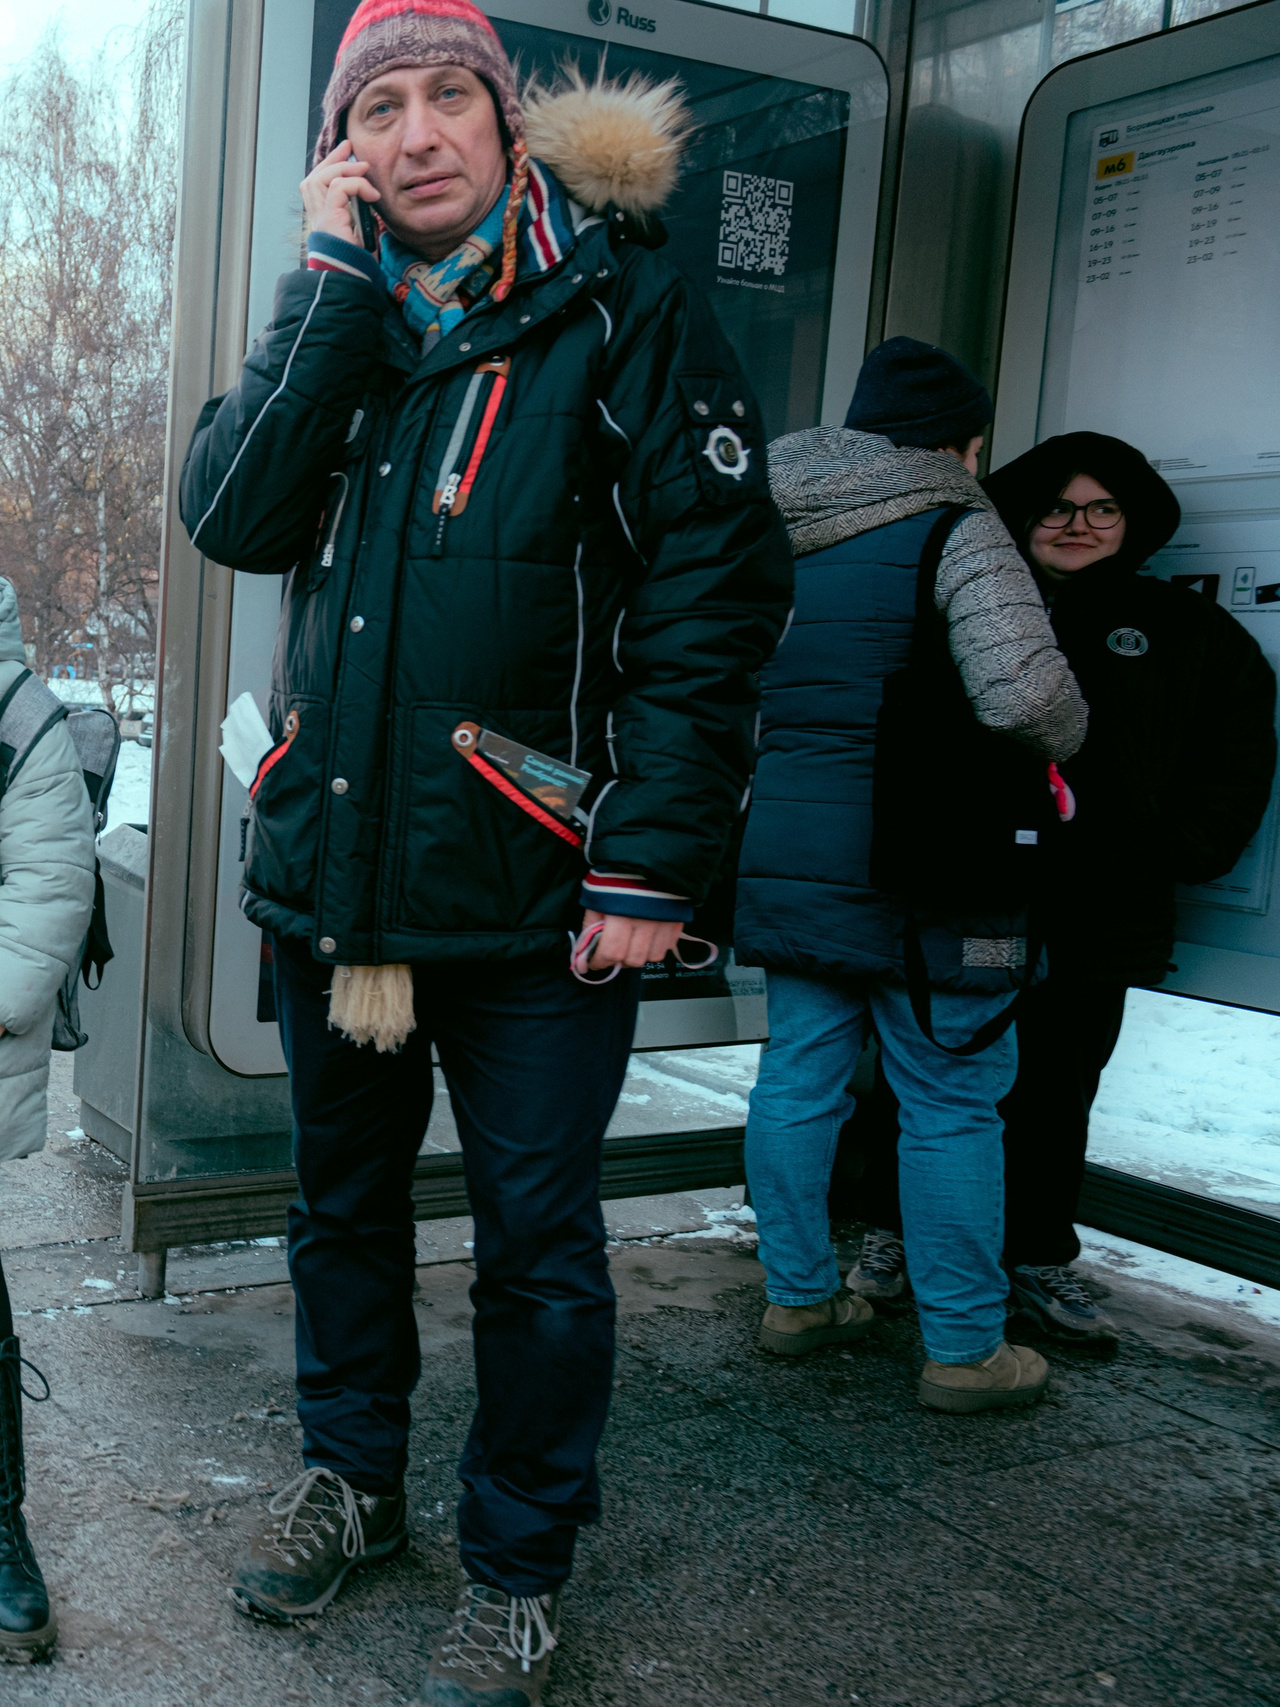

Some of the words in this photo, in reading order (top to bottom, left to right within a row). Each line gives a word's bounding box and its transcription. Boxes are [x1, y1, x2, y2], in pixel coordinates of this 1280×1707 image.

[617, 7, 657, 33] Russ
[716, 275, 740, 286] Узнайте
[740, 279, 763, 290] больше
